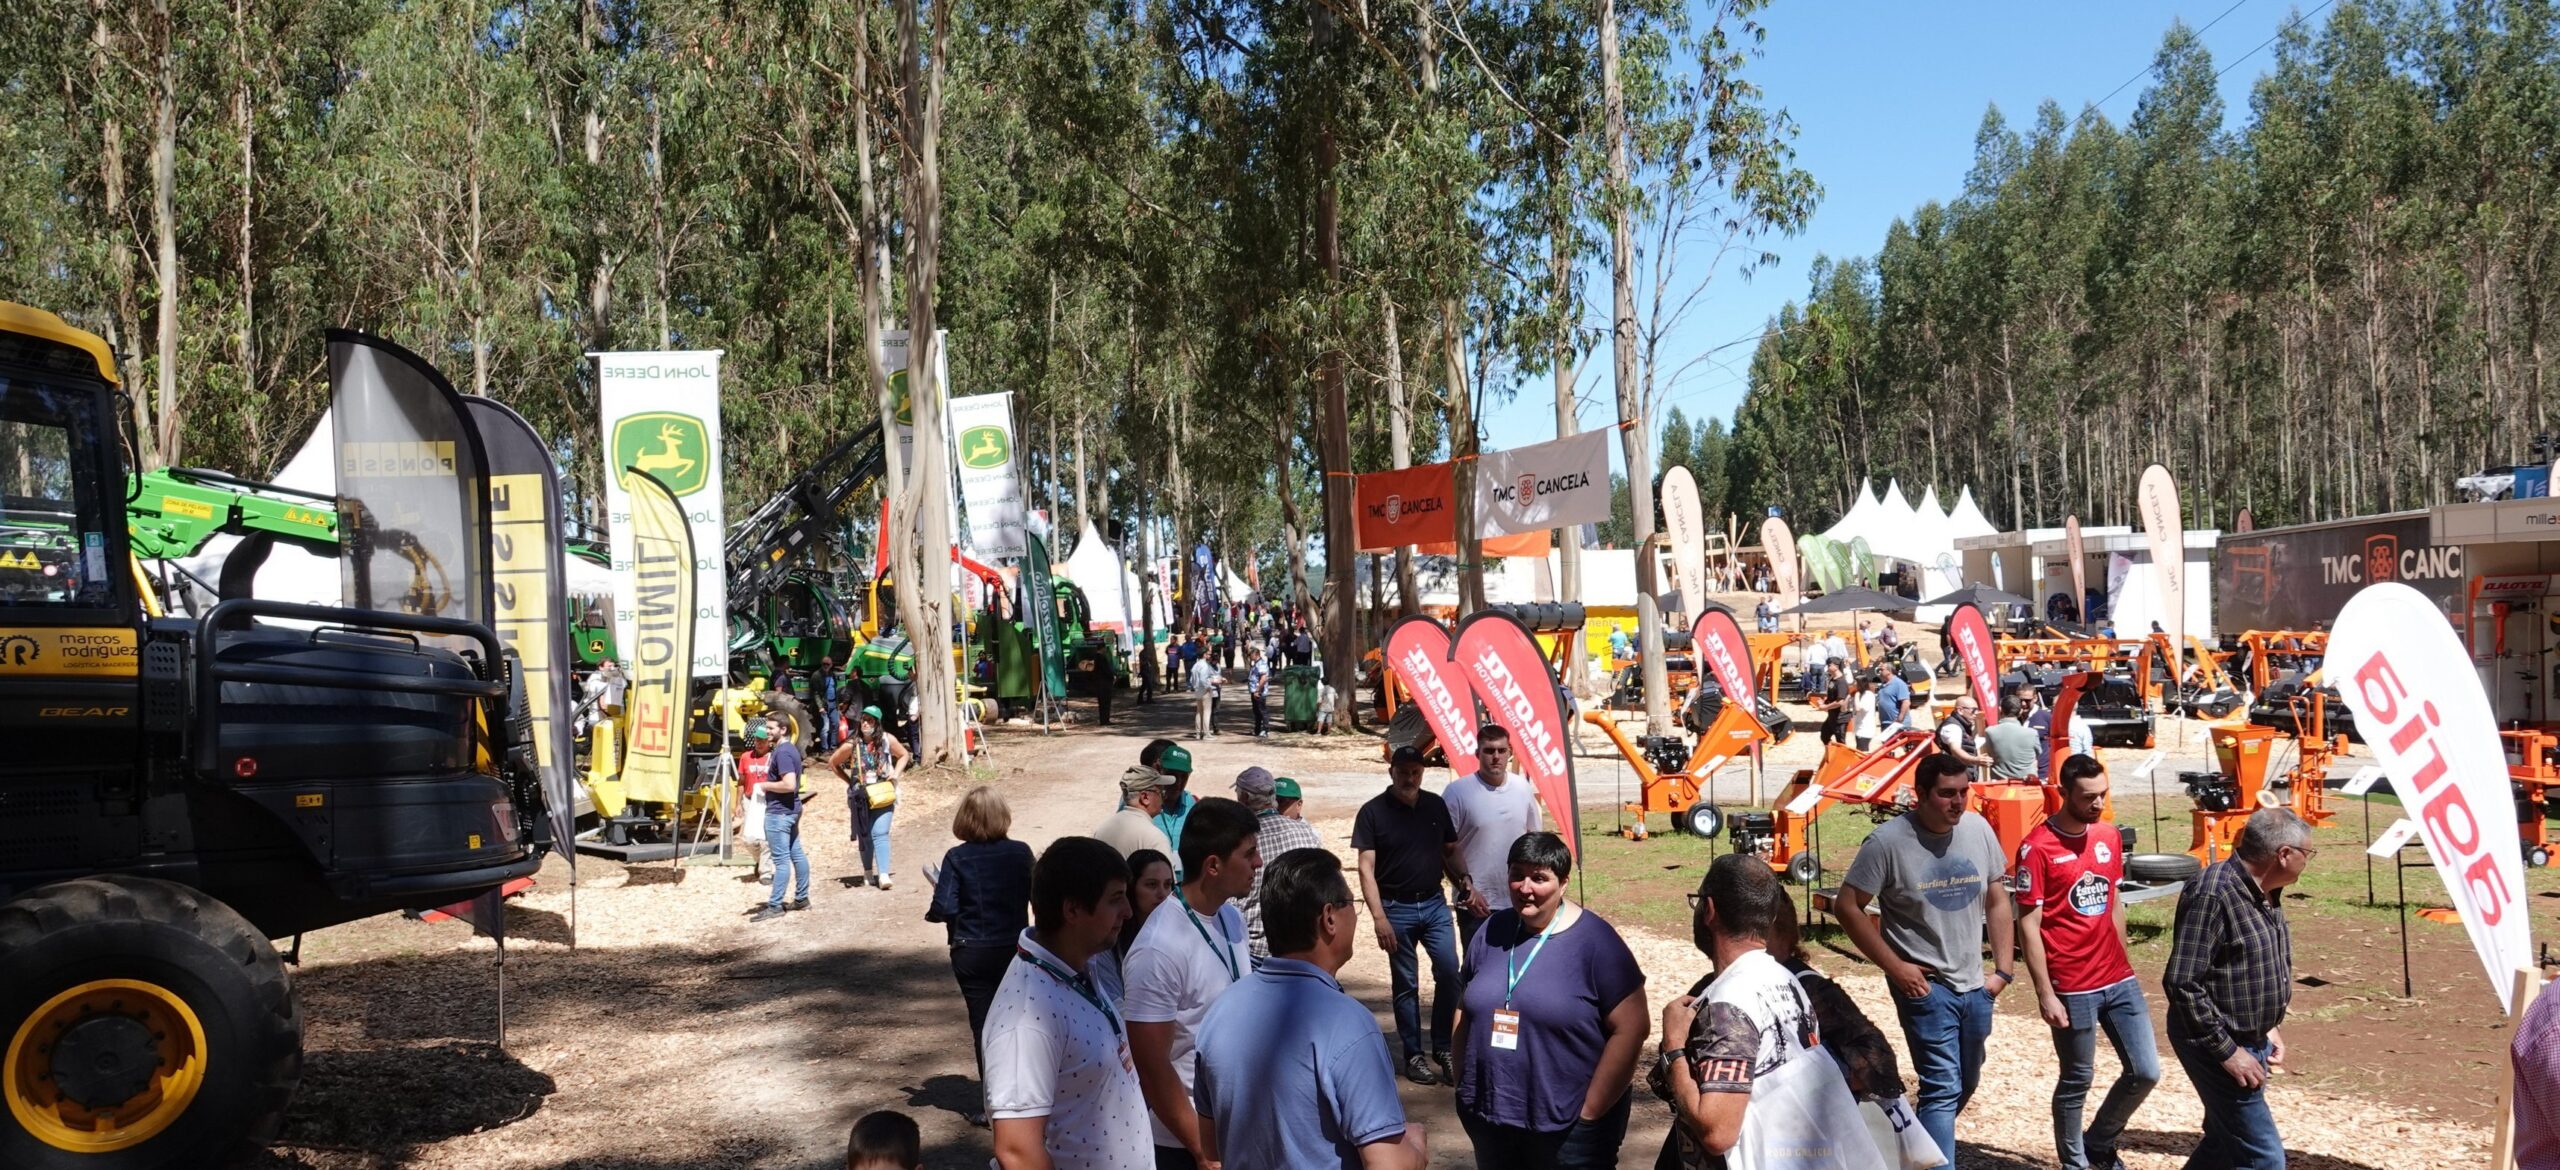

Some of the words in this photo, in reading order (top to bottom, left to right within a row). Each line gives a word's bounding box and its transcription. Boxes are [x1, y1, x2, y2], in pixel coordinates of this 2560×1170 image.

[1493, 485, 1516, 502] TMC
[1536, 474, 1590, 495] CANCELA
[1368, 503, 1386, 517] TMC
[1401, 497, 1443, 515] CANCELA
[2321, 554, 2361, 584] TMC
[2400, 546, 2464, 580] CANC
[60, 634, 120, 645] marcos
[39, 707, 129, 717] BEAR
[1918, 879, 1948, 890] Surfing
[2076, 882, 2109, 897] Estrella
